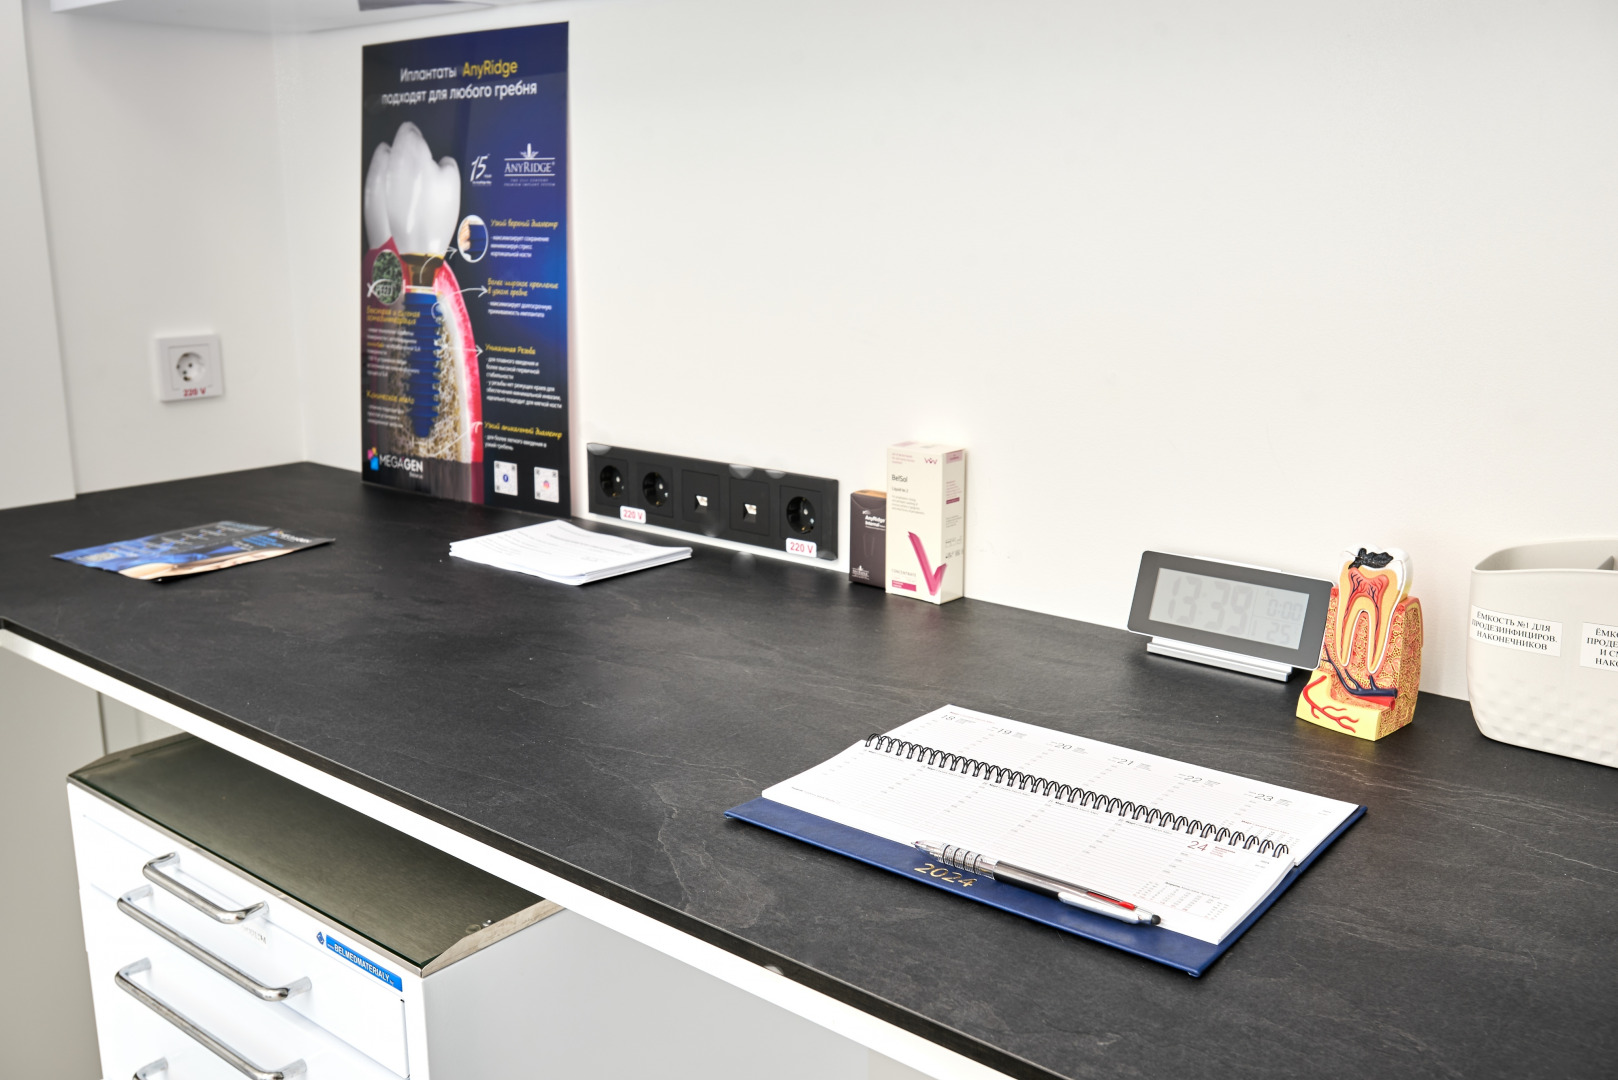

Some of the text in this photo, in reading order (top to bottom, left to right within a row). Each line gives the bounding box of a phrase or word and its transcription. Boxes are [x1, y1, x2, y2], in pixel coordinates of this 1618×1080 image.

[462, 59, 518, 80] AnyRidge
[382, 80, 538, 105] подходят для любого гребня
[470, 155, 488, 182] 15
[379, 454, 424, 473] MEGAGEN
[623, 508, 643, 521] 220 V
[789, 541, 814, 555] 220 V
[1167, 575, 1253, 635] 13:39
[1266, 598, 1304, 622] 0:00
[1472, 618, 1558, 643] ПРОДЕЗИНФИЦИРОВ.
[1476, 610, 1515, 627] ЁМКОСТЬ
[1532, 623, 1551, 632] ДЛЯ
[1265, 621, 1291, 645] 25
[1476, 630, 1548, 651] НАКОНЕЧНИКОВ
[1595, 627, 1618, 639] ЁМК
[1600, 648, 1607, 656] И
[1054, 742, 1073, 750] 20
[1116, 758, 1134, 766] 21
[1183, 775, 1203, 784] 22
[1254, 793, 1274, 802] 23
[1187, 841, 1208, 852] 24
[914, 862, 978, 889] 2024
